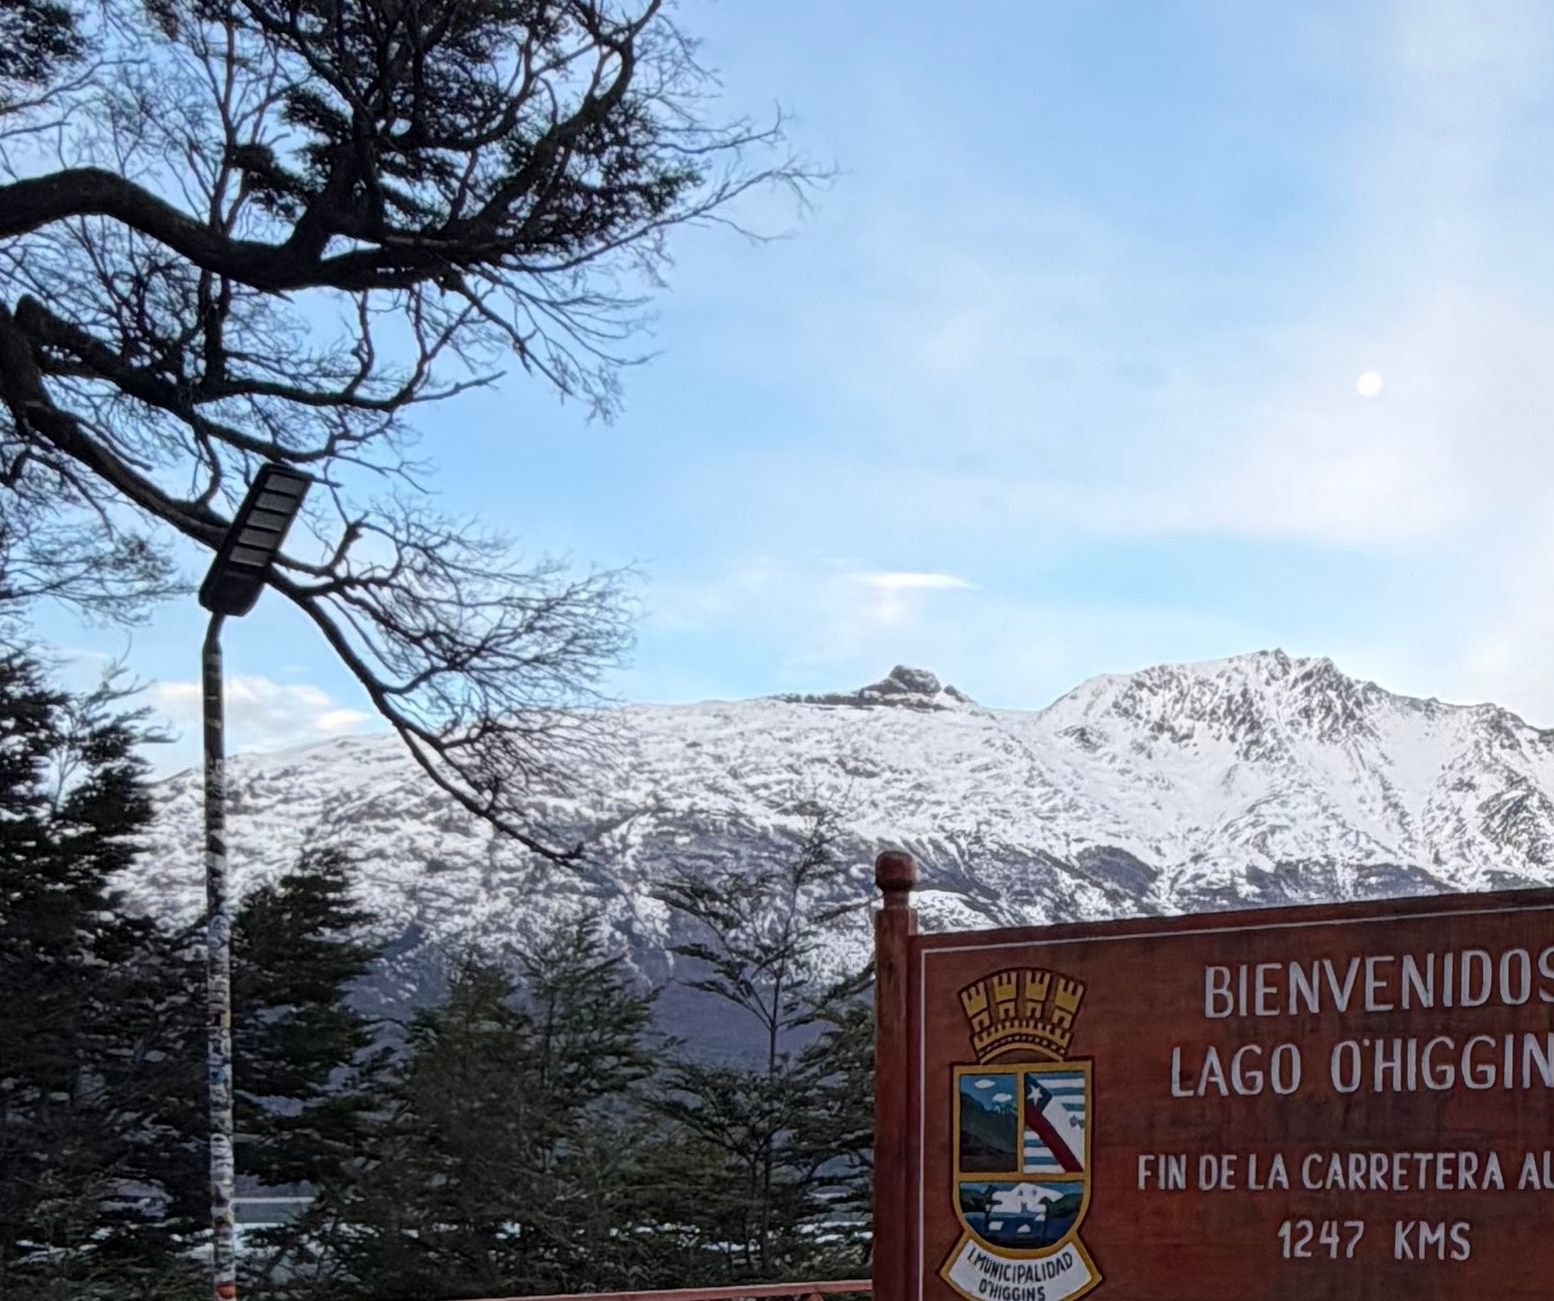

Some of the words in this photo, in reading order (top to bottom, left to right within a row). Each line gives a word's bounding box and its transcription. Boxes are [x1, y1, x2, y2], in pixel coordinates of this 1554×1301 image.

[1170, 1042, 1302, 1098] LAGO
[1137, 1153, 1188, 1191] FIN
[1198, 1153, 1238, 1191] DE
[1247, 1152, 1290, 1191] LA
[1301, 1151, 1505, 1191] CARRETERA
[1277, 1219, 1365, 1260] 1247
[1393, 1219, 1471, 1261] KMS
